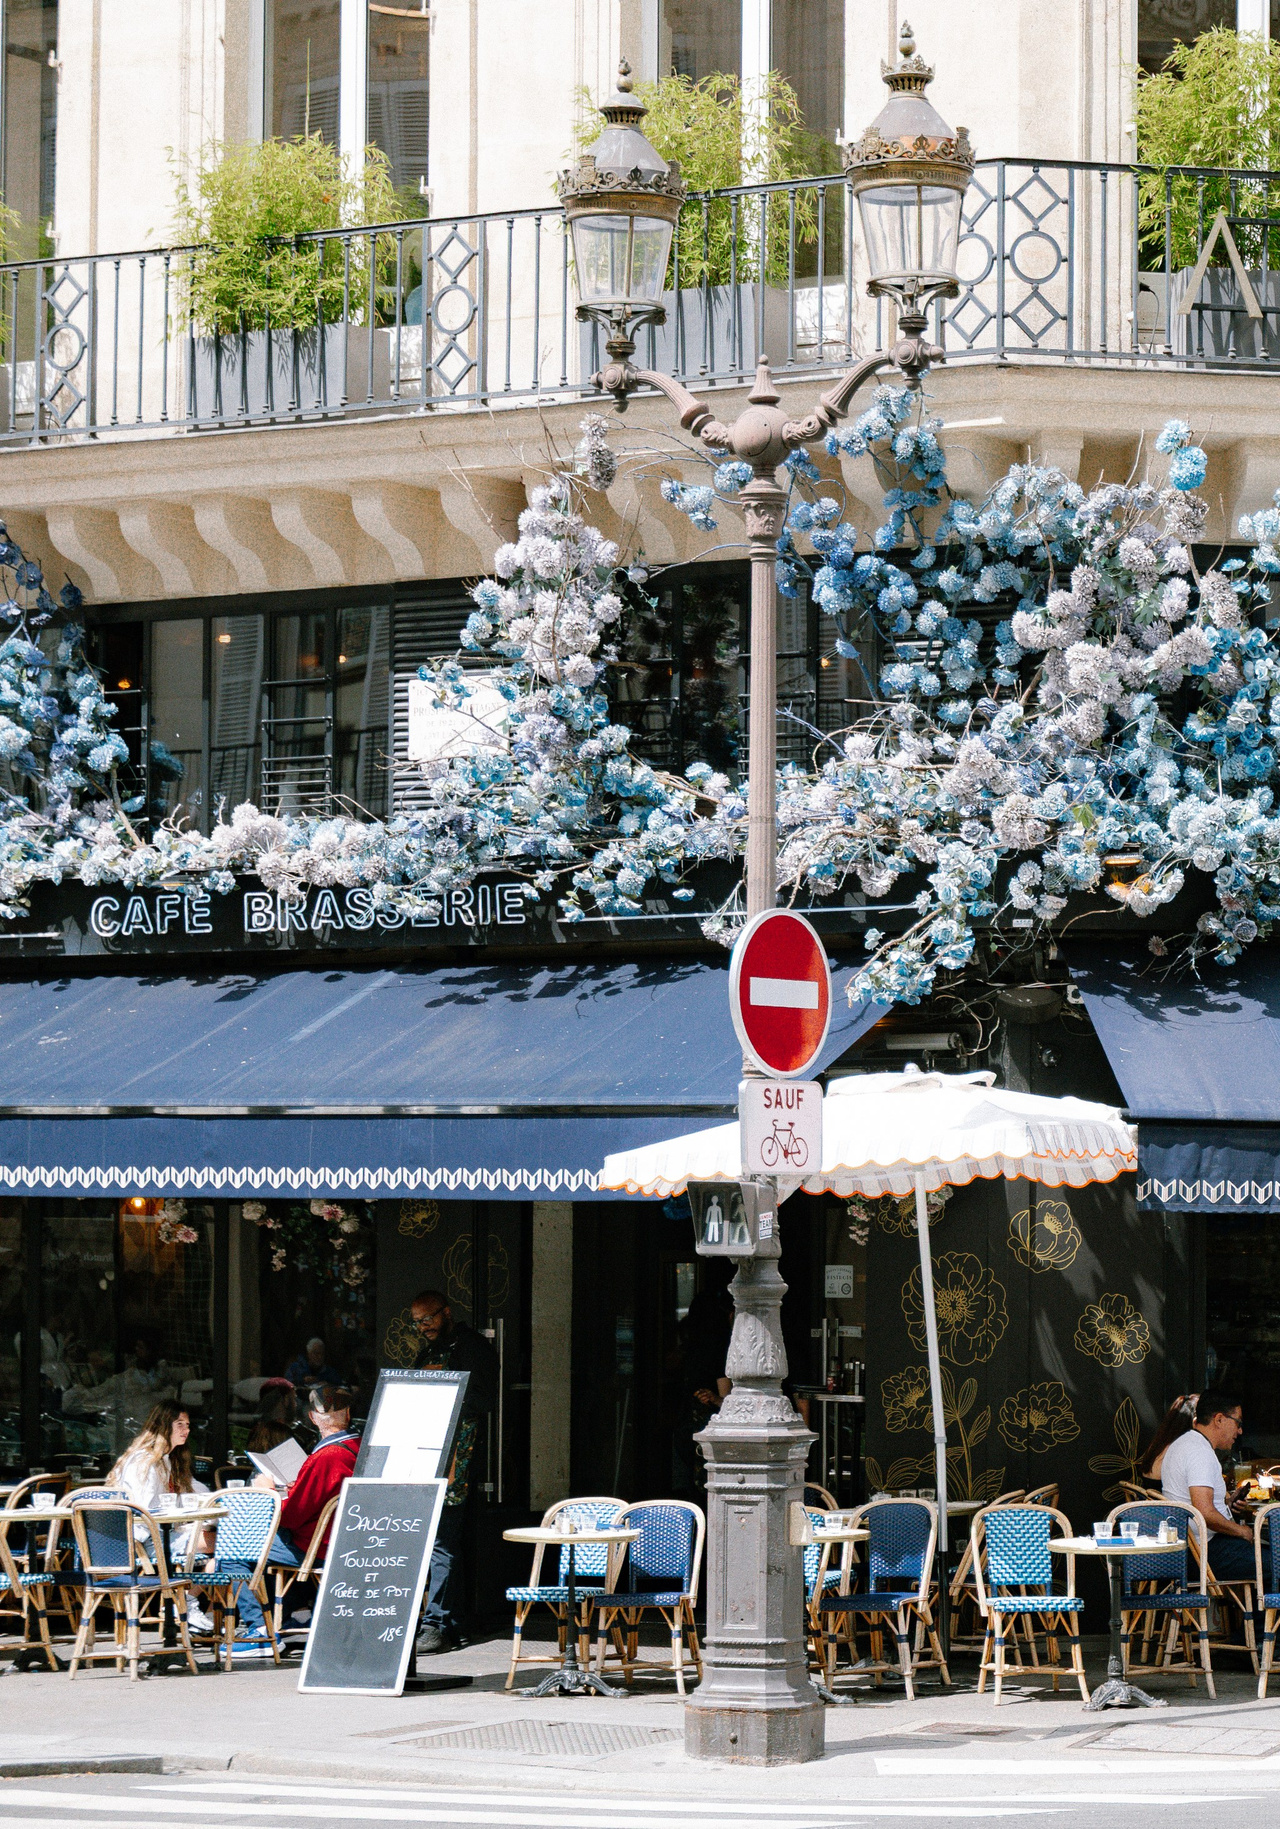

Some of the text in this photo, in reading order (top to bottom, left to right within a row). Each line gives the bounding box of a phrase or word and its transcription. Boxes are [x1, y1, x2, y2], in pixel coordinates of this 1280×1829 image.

[763, 1087, 805, 1110] SAUF
[345, 1504, 423, 1533] SAUCISSE
[363, 1536, 390, 1549] DE
[339, 1550, 409, 1568] TOULOUSE
[364, 1572, 379, 1582] ET
[364, 1589, 380, 1599] DE
[383, 1585, 412, 1598] PDT
[332, 1604, 355, 1617] JUS
[378, 1625, 404, 1642] 18€
